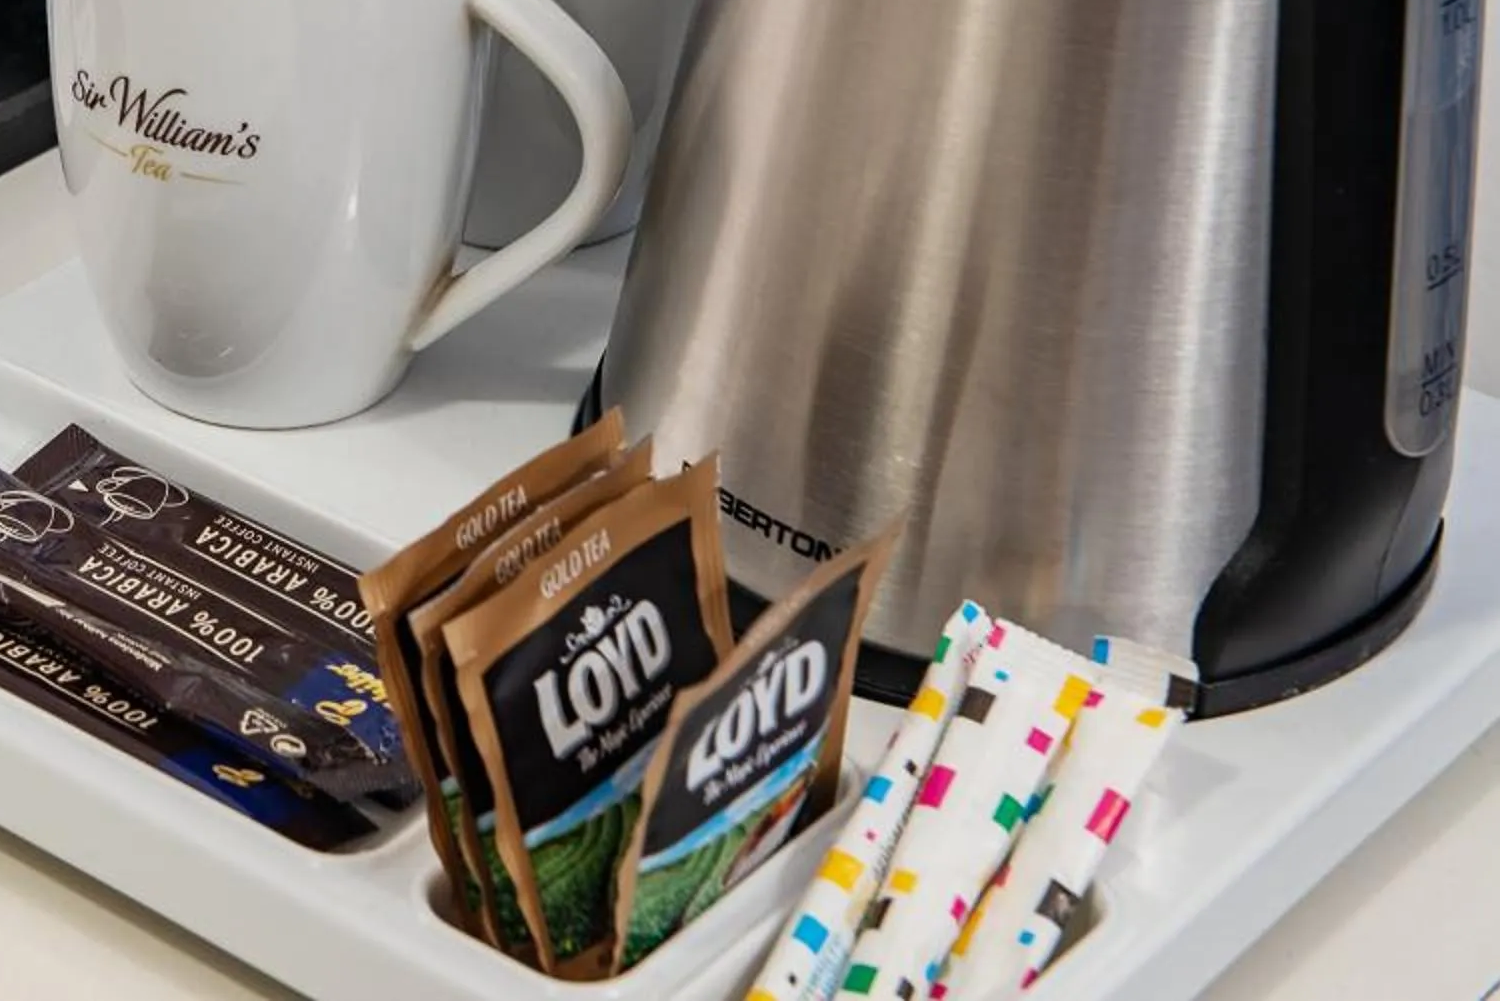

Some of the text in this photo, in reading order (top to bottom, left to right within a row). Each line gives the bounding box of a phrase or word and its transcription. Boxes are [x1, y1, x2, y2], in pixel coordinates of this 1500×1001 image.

[71, 70, 261, 160] Sir William's
[129, 143, 174, 182] Tea
[213, 515, 320, 574] INSTANT COFFEE
[455, 484, 529, 550] GOLD TEA
[78, 555, 191, 617] ARABICA
[97, 542, 202, 600] INSTANT COFFEE
[195, 526, 309, 593] ARABICA
[540, 528, 612, 600] GOLD TEA
[189, 610, 266, 664] 100%
[83, 684, 160, 730] 100%
[533, 599, 672, 761] LOYD
[686, 639, 828, 792] LOYD
